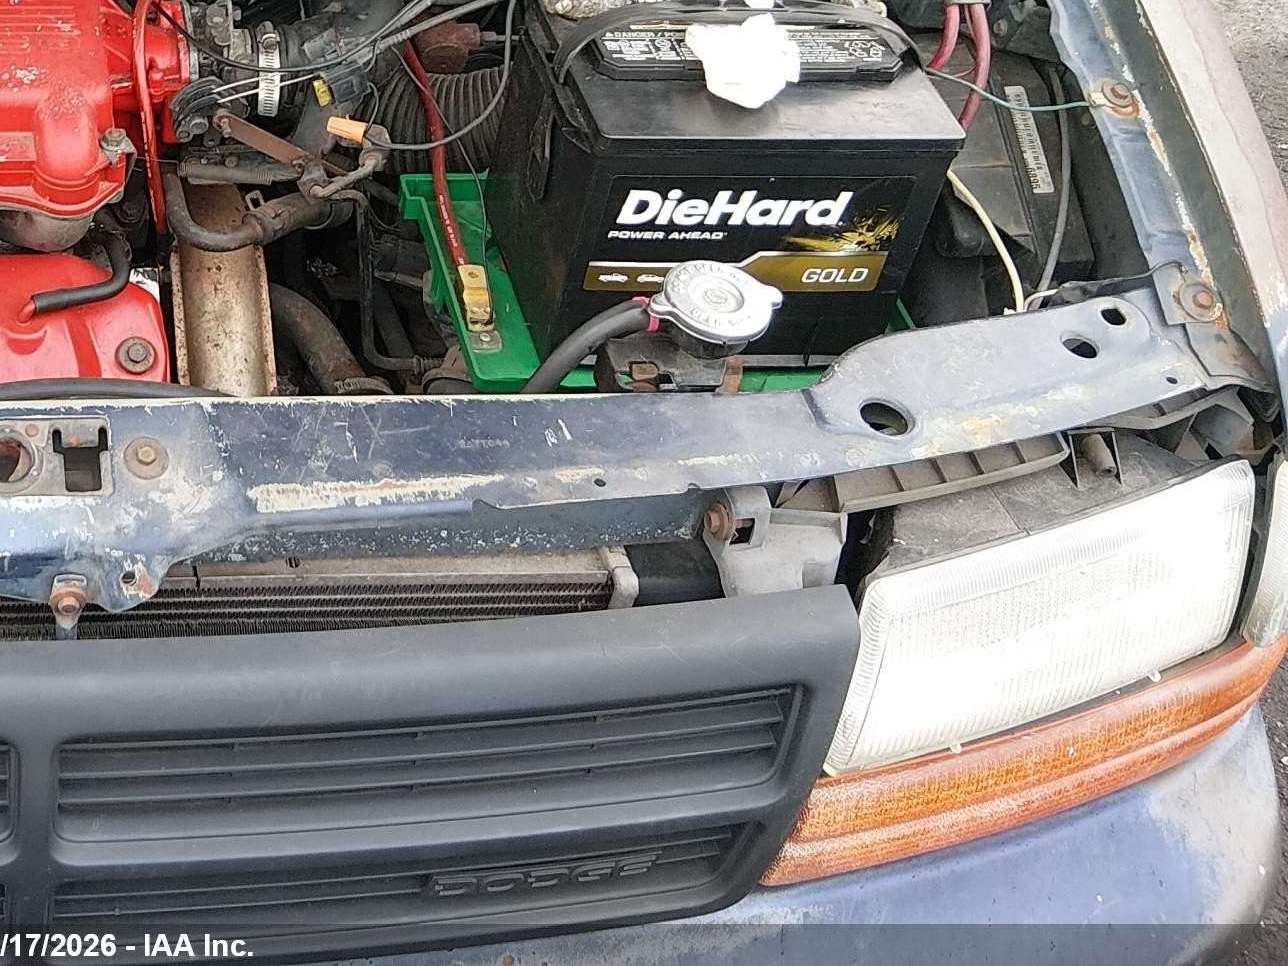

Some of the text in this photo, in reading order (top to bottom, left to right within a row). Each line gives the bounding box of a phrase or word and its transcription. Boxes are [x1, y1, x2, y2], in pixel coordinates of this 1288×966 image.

[616, 188, 855, 228] DieHard
[607, 230, 728, 240] POWER AHEAD
[801, 266, 869, 284] GOLD
[431, 855, 657, 896] DODGE
